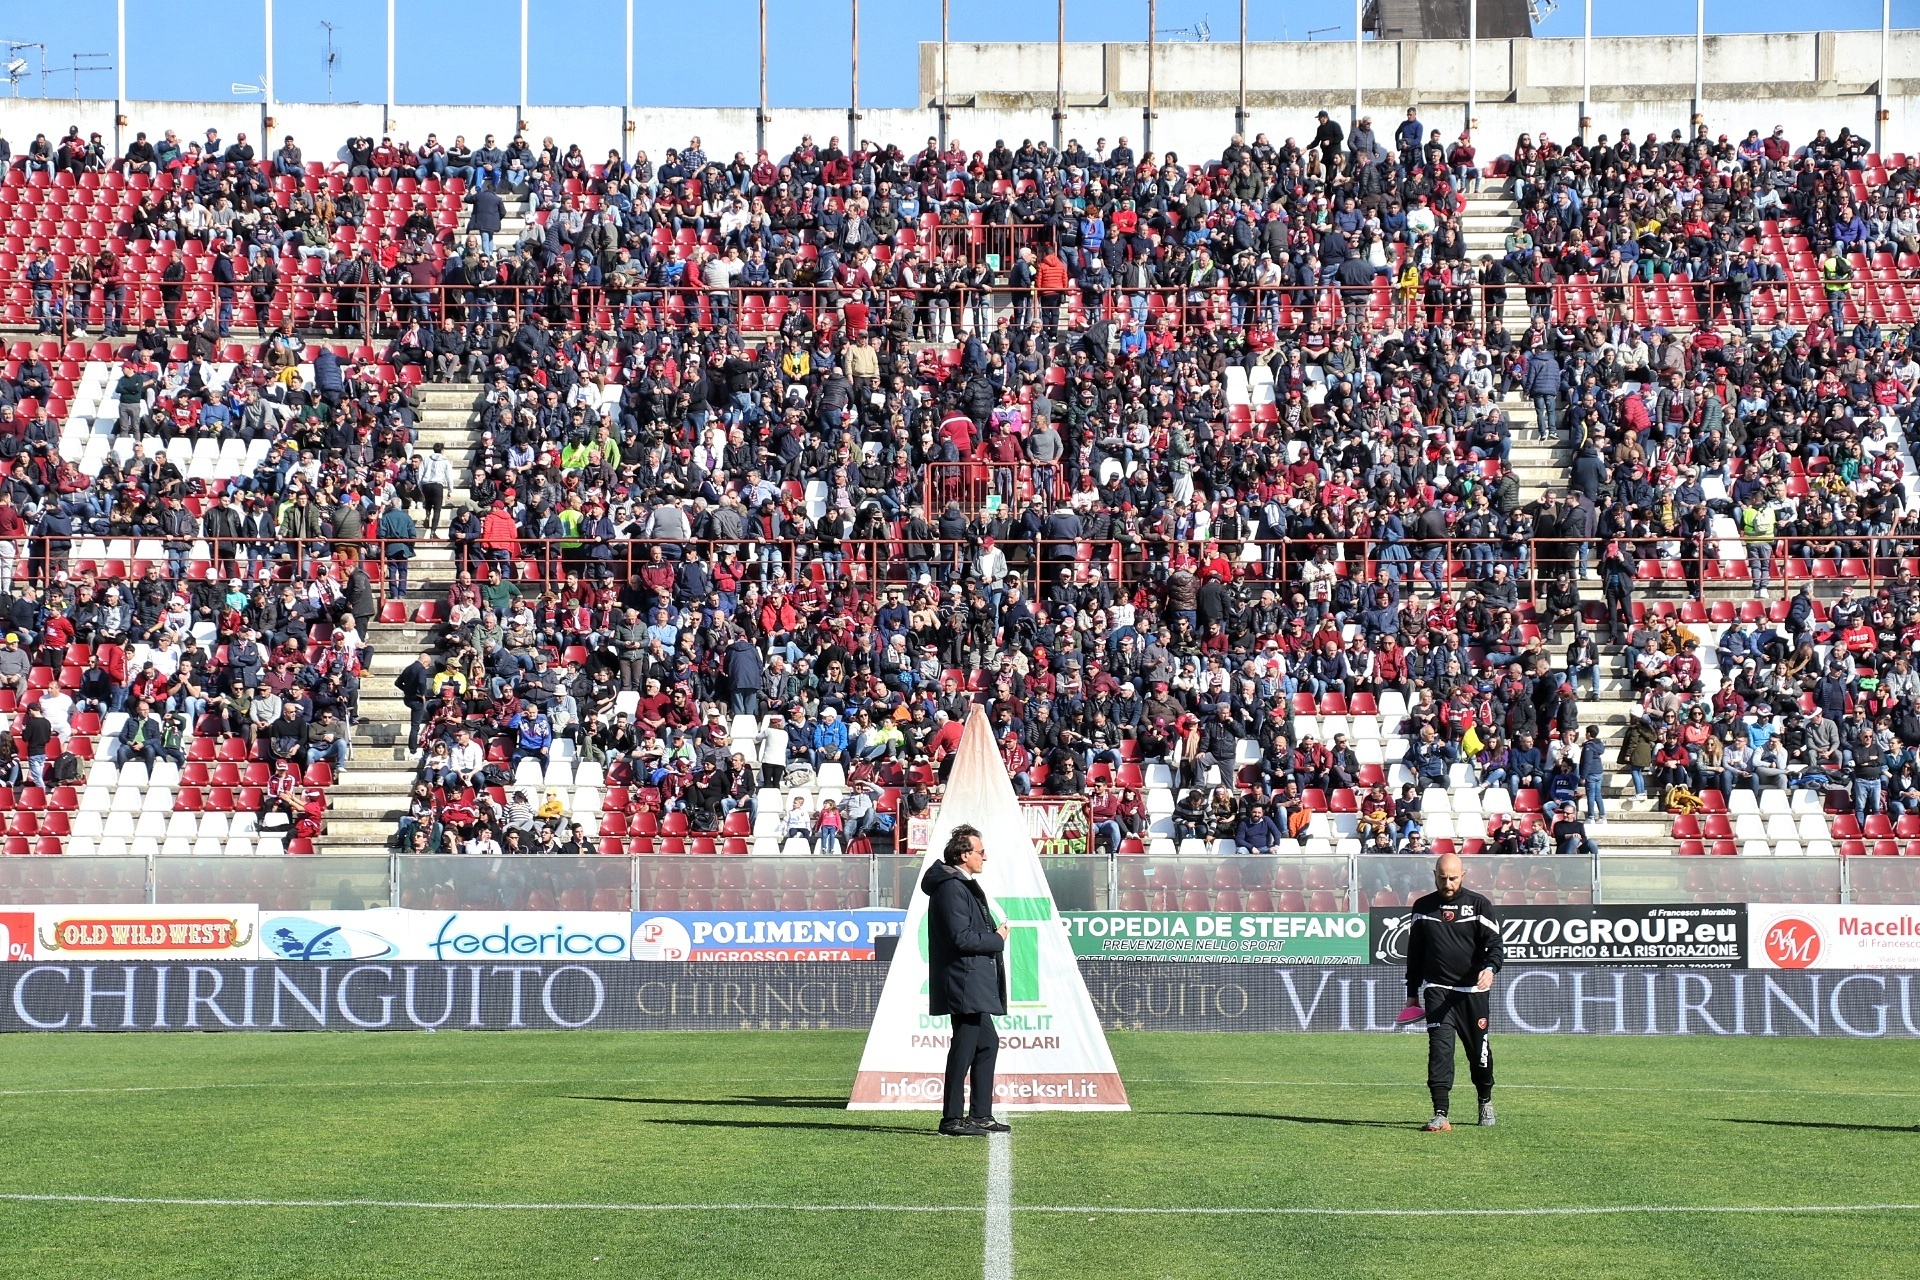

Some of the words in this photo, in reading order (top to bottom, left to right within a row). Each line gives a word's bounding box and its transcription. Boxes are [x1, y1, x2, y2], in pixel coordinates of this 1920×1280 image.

[1461, 904, 1474, 917] GS
[1648, 908, 1657, 916] di
[1657, 909, 1699, 917] Francesco
[1701, 908, 1737, 916] Morabito
[63, 924, 108, 945] OLD
[112, 924, 168, 945] WILD
[170, 923, 232, 944] WEST
[428, 913, 627, 960] federico
[692, 920, 860, 944] POLIMENO
[1060, 916, 1190, 937] RTOPEDIA
[1196, 916, 1232, 938] DE
[1239, 917, 1367, 938] STEFANO
[1501, 918, 1737, 945] ZIOGROUP.eu
[1102, 939, 1194, 951] PREVENZIONE
[1195, 939, 1238, 951] NELLO
[1241, 940, 1285, 951] SPORT
[1529, 945, 1597, 958] L'UFFICIO
[1599, 945, 1610, 957] &
[1613, 945, 1632, 957] LA
[1636, 944, 1739, 957] RISTORAZIONE
[1858, 938, 1868, 948] di
[696, 951, 789, 961] INGROSSO
[794, 951, 851, 961] CARTA
[13, 965, 605, 1029] CHIRINGUITO
[637, 981, 880, 1016] CHIRINGUI
[1276, 969, 1410, 1032] VIL
[998, 1036, 1060, 1050] SOLARI
